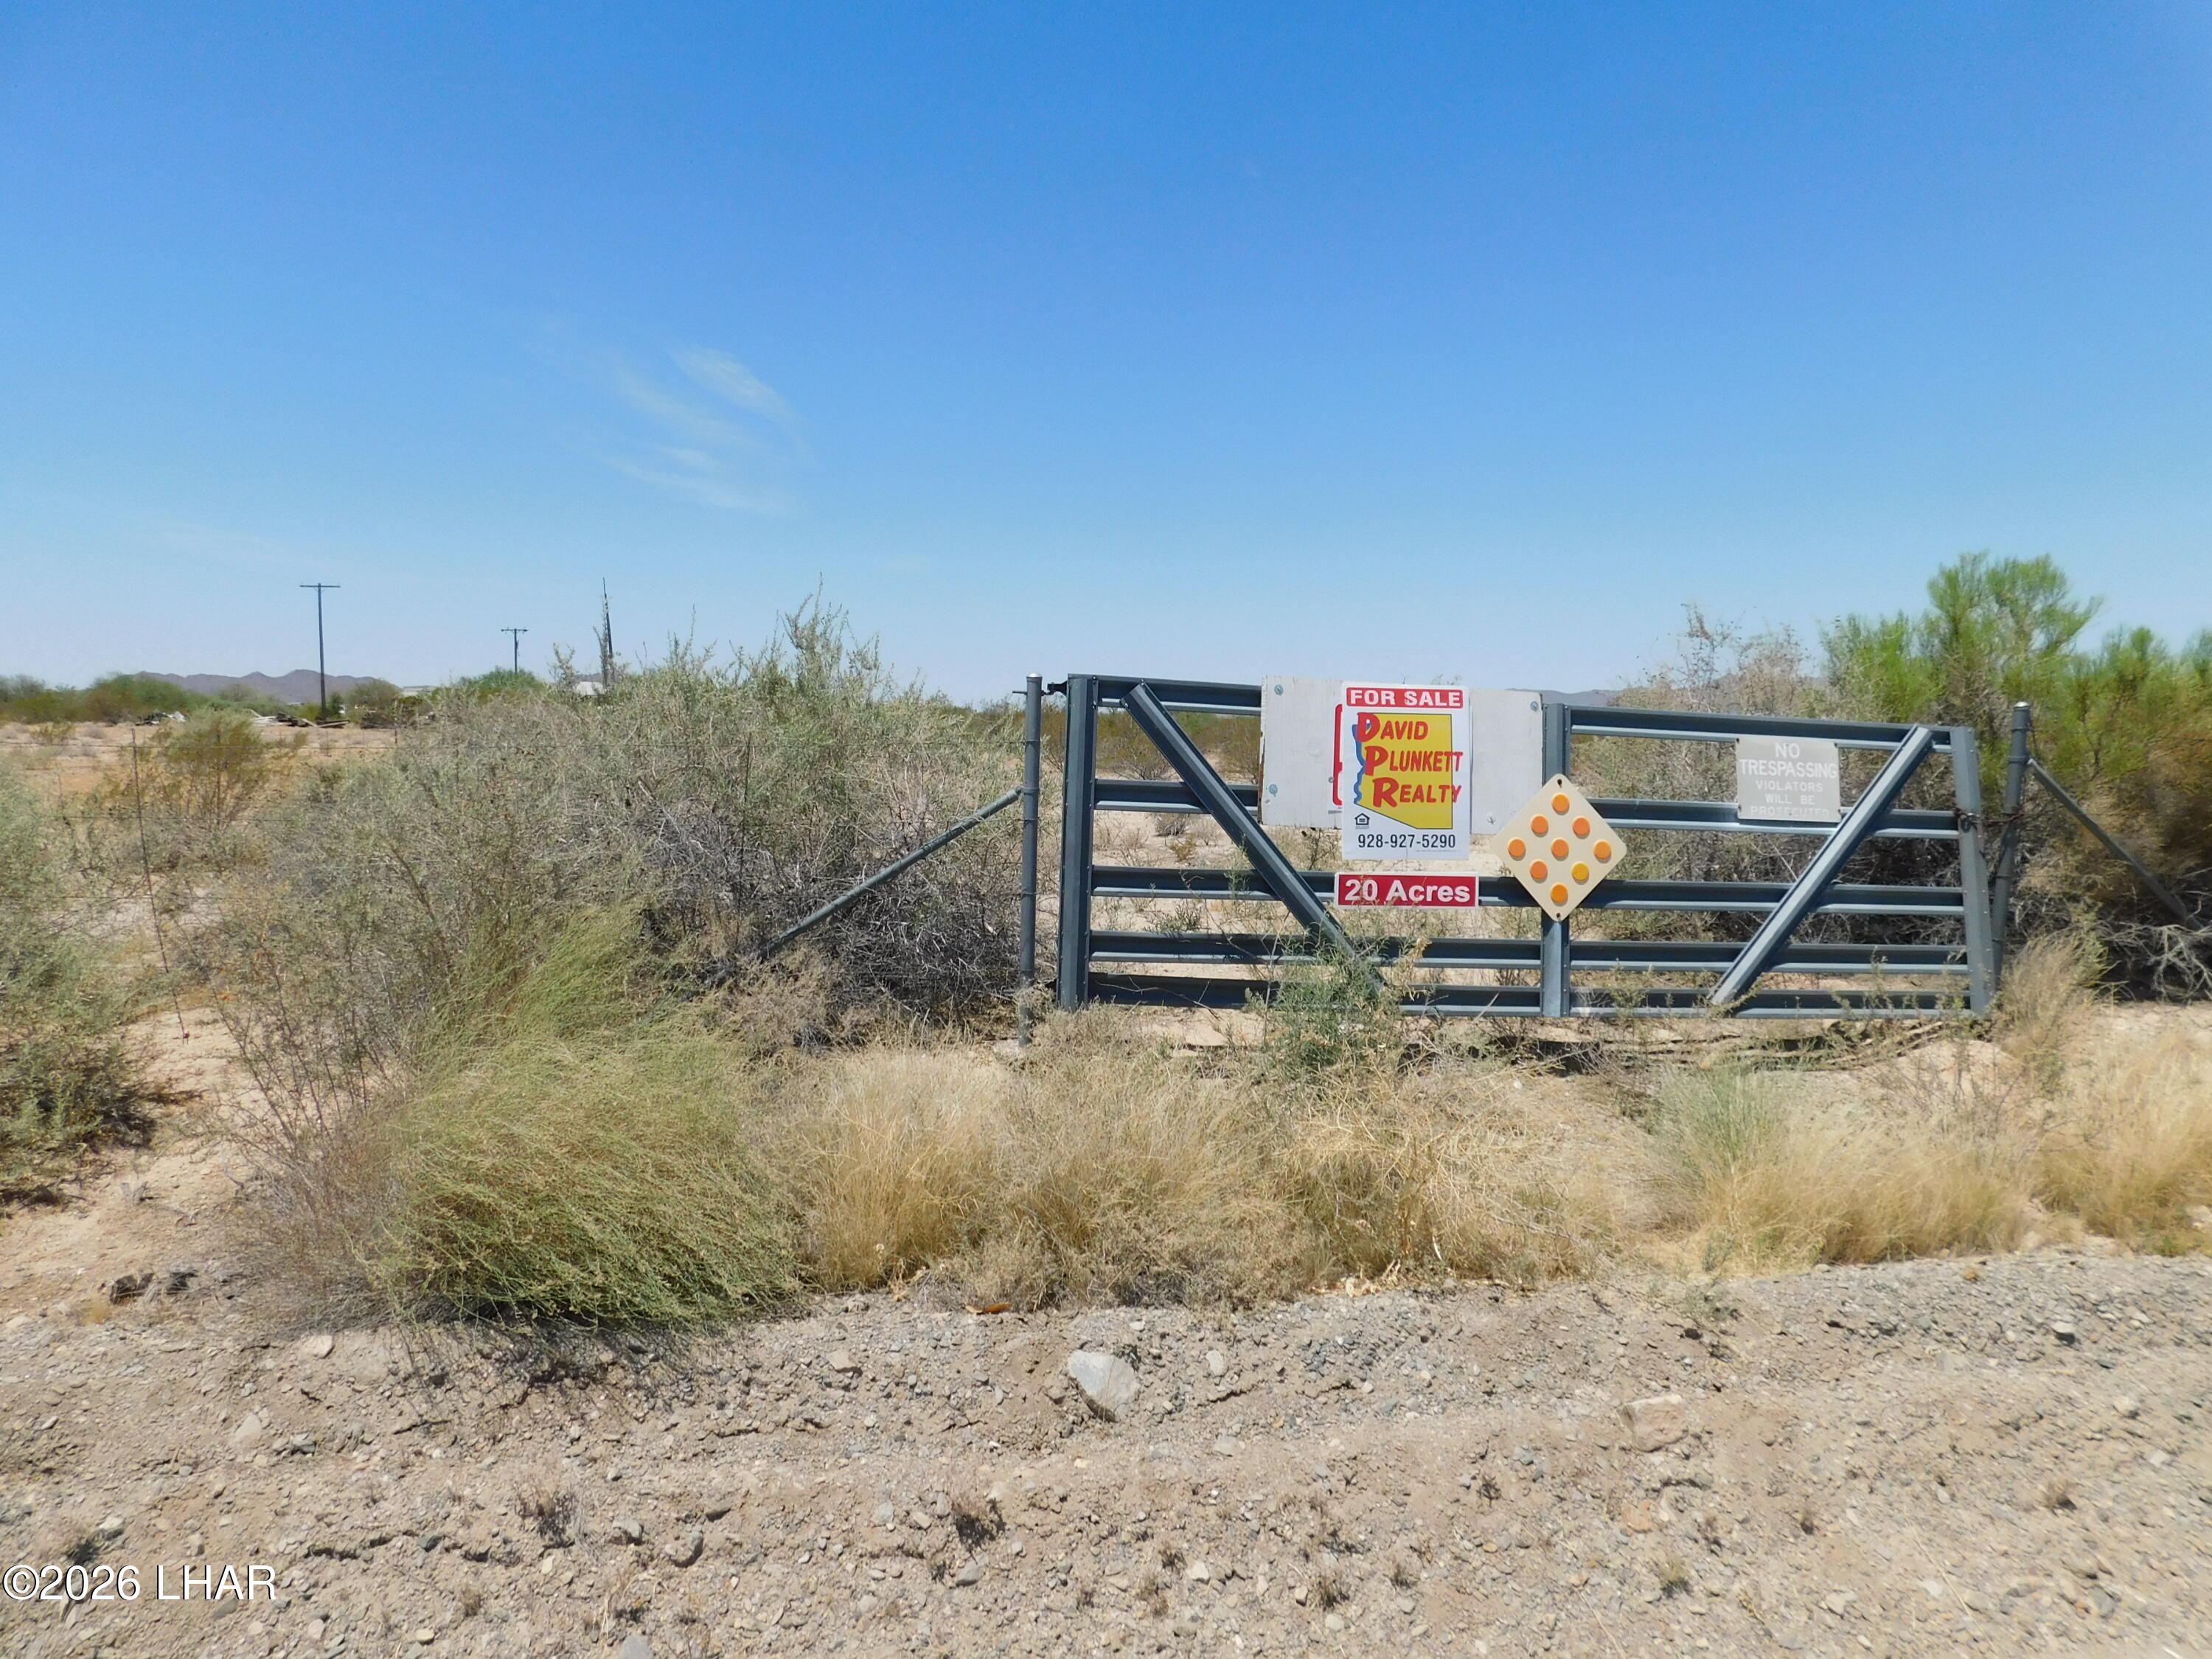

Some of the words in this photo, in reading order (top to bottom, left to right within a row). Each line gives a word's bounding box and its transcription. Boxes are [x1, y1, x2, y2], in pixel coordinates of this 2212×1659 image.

[1350, 689, 1396, 705] FOR
[1404, 691, 1461, 706] SALE
[1357, 712, 1429, 742] DAVID
[1775, 742, 1801, 759] NO
[1364, 745, 1464, 776] PLUNKETT
[1739, 759, 1837, 779] TRESPASSING
[1372, 777, 1462, 807] REALTY
[1756, 779, 1823, 793] VIOLATORS
[1765, 793, 1792, 804] WILL
[1800, 795, 1816, 805] BE
[1358, 834, 1456, 848] 928-927-5290
[1344, 879, 1378, 901] 20
[1385, 880, 1470, 902] Acres
